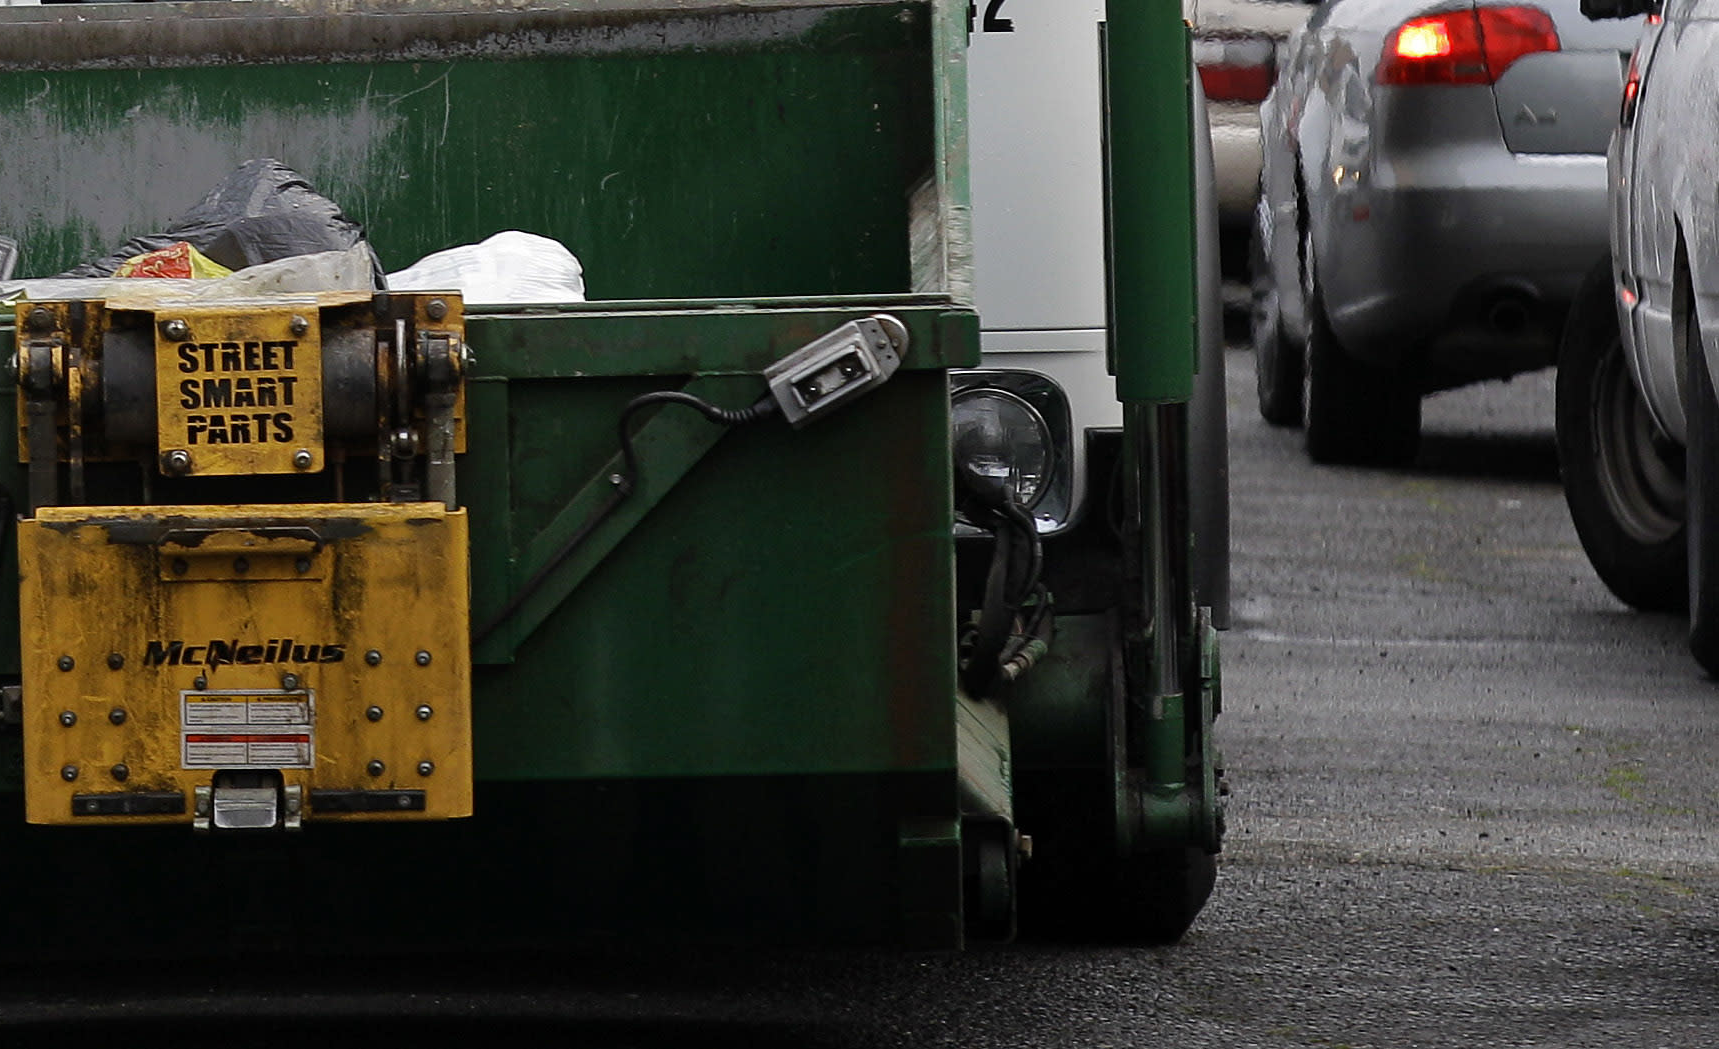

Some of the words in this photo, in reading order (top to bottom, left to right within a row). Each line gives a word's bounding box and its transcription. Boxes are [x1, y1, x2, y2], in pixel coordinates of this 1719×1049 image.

[177, 340, 299, 374] STREET
[179, 376, 299, 410] SMART
[186, 412, 295, 445] PARTS
[143, 638, 347, 673] McNeilus
